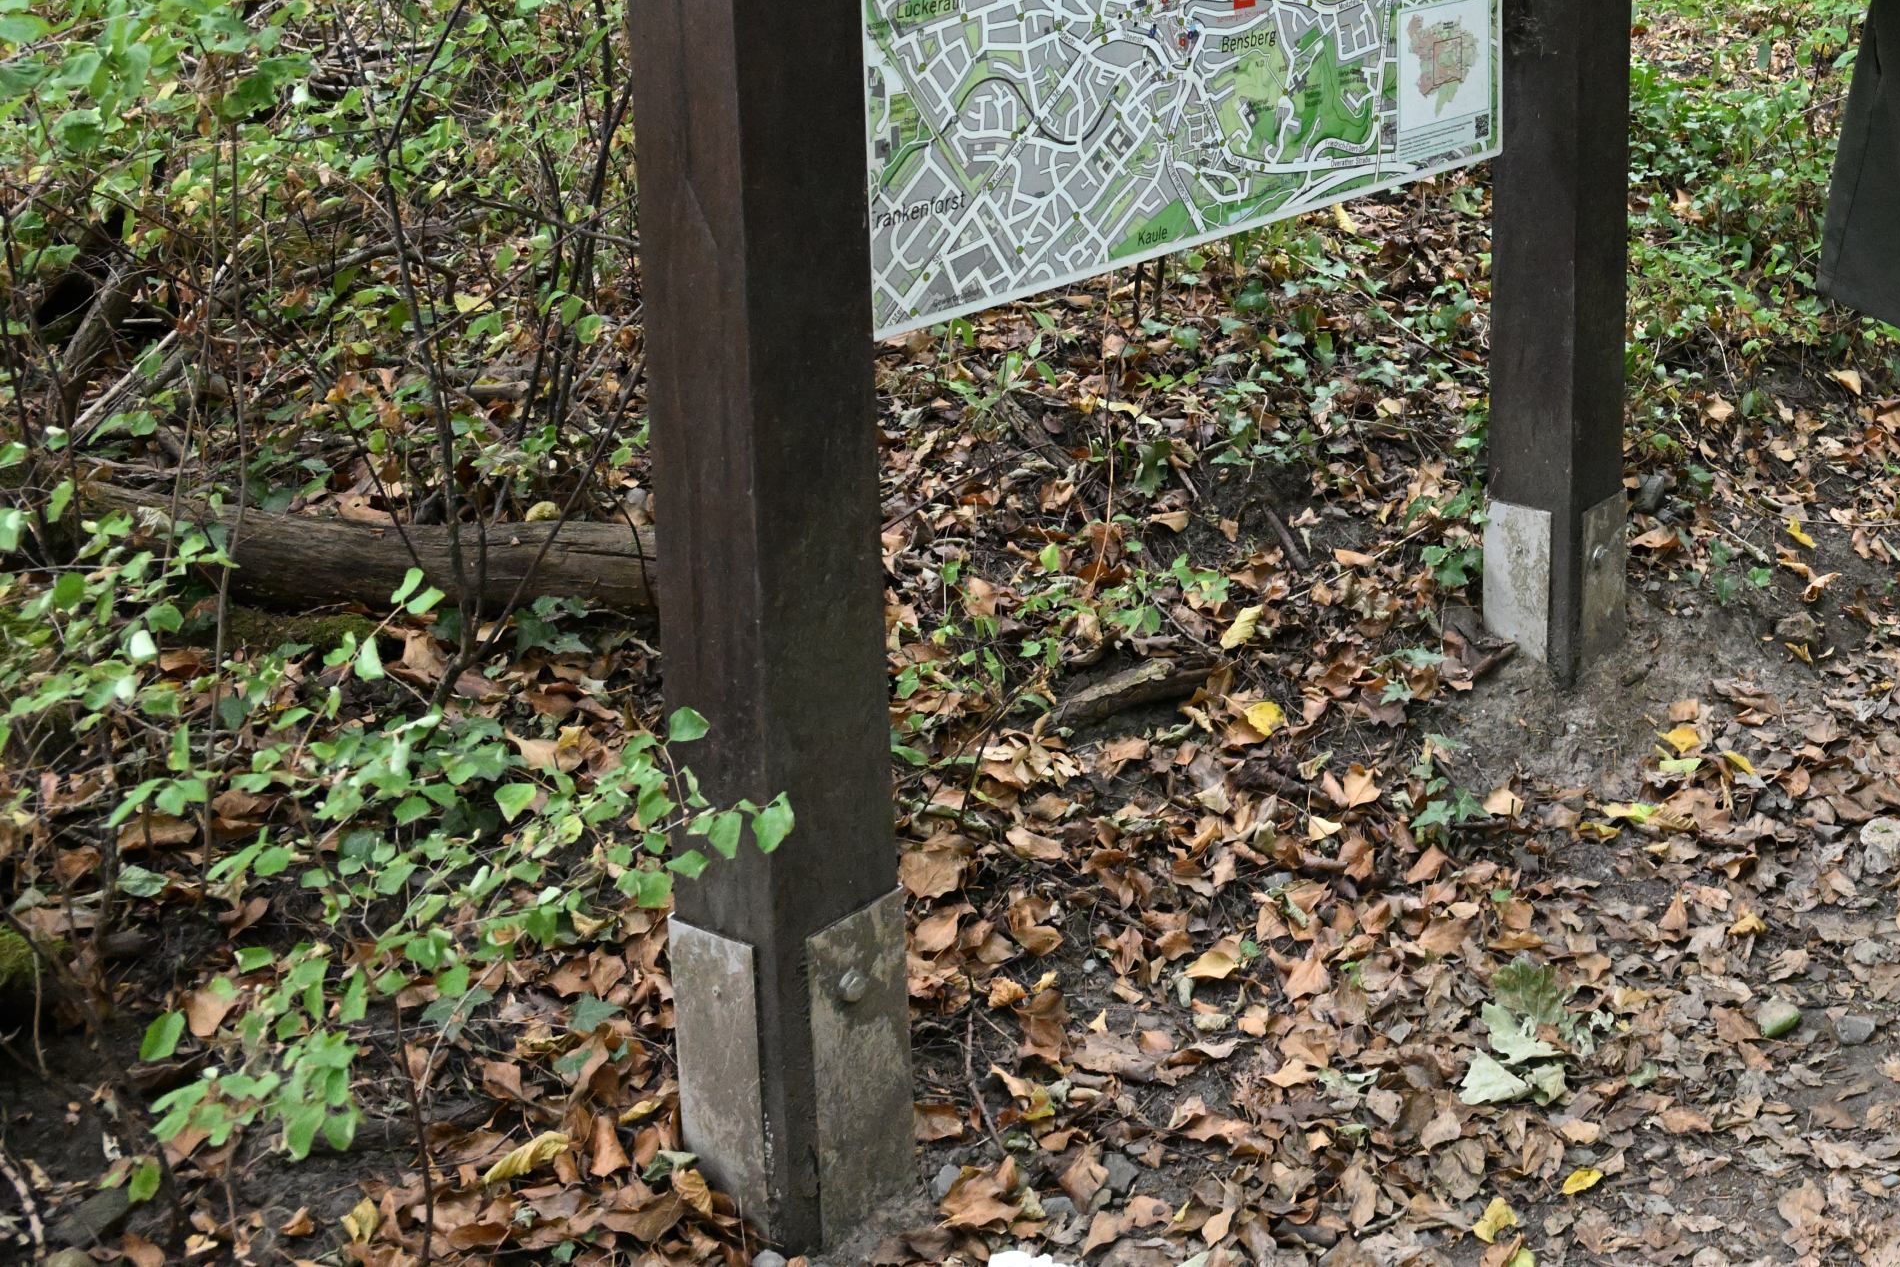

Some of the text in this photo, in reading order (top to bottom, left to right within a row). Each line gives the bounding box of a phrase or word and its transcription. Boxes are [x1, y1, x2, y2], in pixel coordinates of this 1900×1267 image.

[1221, 30, 1277, 53] Bensberg
[874, 191, 965, 229] rankenforst
[1136, 226, 1169, 246] Kaule
